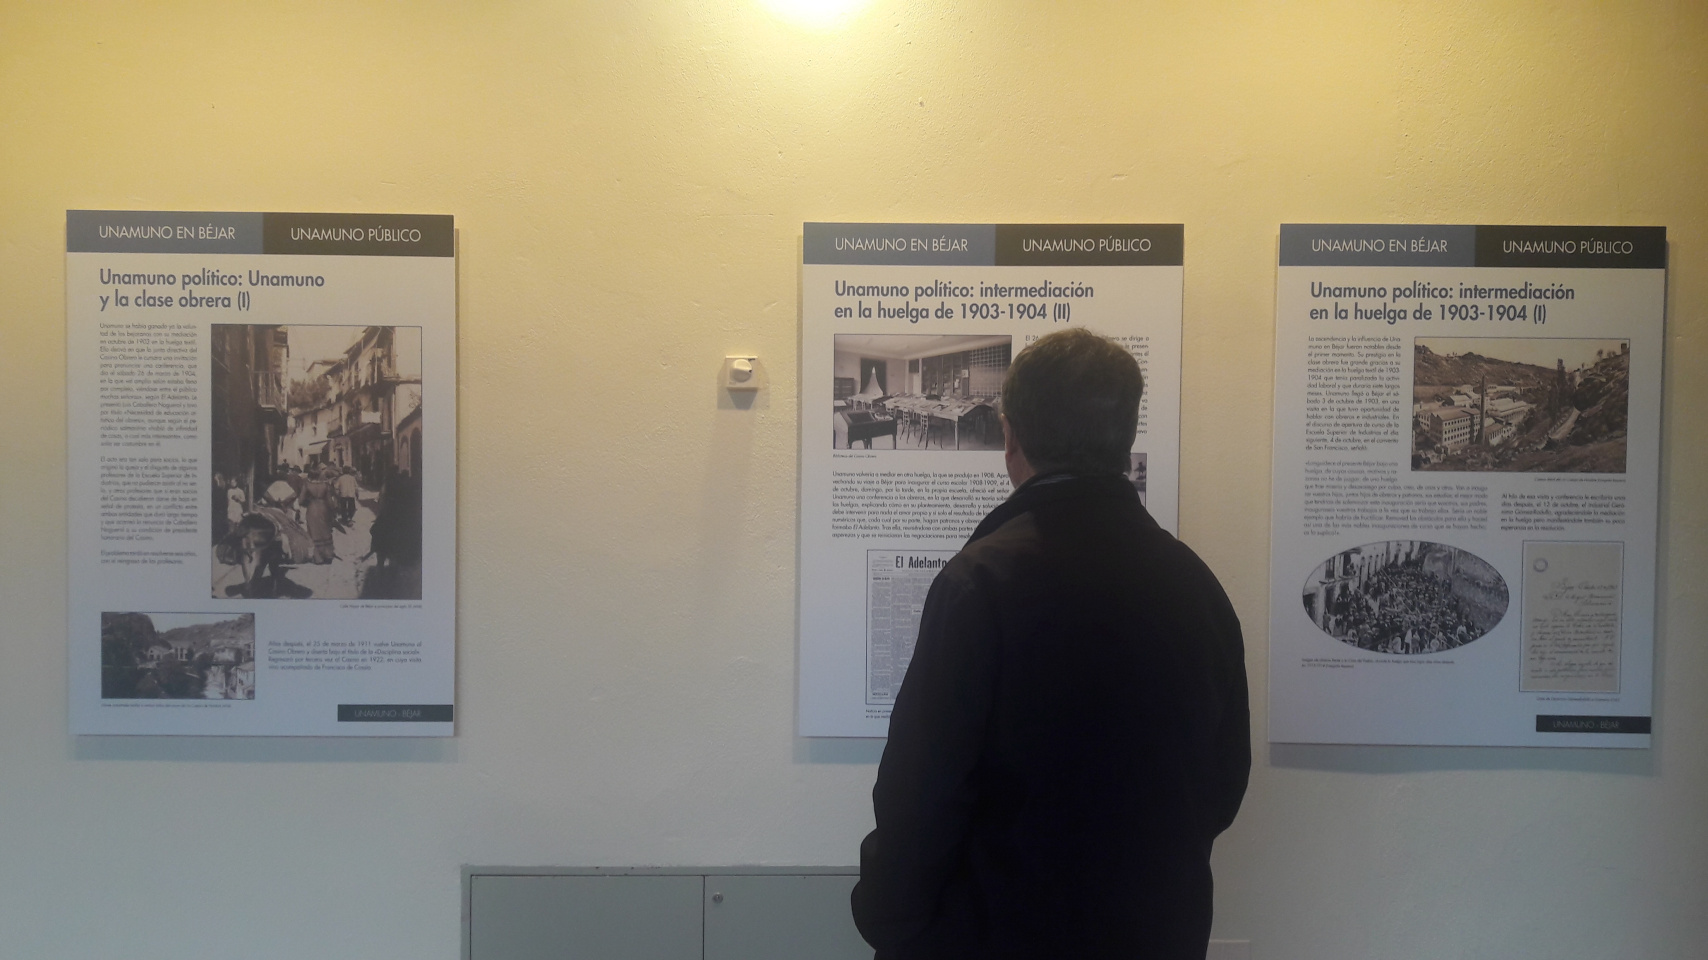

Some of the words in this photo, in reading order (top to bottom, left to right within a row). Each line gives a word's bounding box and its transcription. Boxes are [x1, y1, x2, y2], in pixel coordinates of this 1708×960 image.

[99, 225, 173, 240] UNAMUNO
[176, 225, 195, 240] EN
[198, 222, 236, 240] BÉJAR
[290, 227, 365, 242] UNAMUNO
[368, 224, 422, 243] PÚBLICO
[835, 237, 907, 252] UNAMUNO
[910, 238, 928, 252] EN
[932, 234, 969, 252] BÉJAR
[1022, 238, 1096, 252] UNAMUNO
[1099, 235, 1152, 252] PÚBLICO
[1311, 238, 1386, 253] UNAMUNO
[1388, 238, 1407, 253] EN
[1410, 236, 1448, 253] BÉJAR
[1502, 239, 1577, 254] UNAMUNO
[1580, 237, 1634, 255] PÚBLICO
[99, 267, 177, 286] Unamuno
[181, 267, 243, 290] político:
[248, 269, 325, 288] Unamuno
[98, 295, 110, 313] y
[114, 288, 130, 308] la
[134, 288, 174, 308] clase
[178, 288, 232, 309] obrera
[237, 290, 251, 312] (I)
[834, 279, 910, 298] Unamuno
[914, 279, 975, 304] político:
[979, 279, 1094, 299] intermediación
[1310, 281, 1388, 299] Unamuno
[1392, 280, 1454, 304] político:
[1459, 280, 1575, 300] intermediación
[834, 306, 853, 319] en
[858, 300, 872, 319] la
[877, 299, 930, 324] huelga
[934, 300, 954, 320] de
[960, 302, 1048, 320] 1903-1904
[1053, 302, 1071, 323] (II)
[1309, 308, 1329, 321] en
[1334, 301, 1349, 321] la
[1353, 300, 1408, 326] huelga
[1412, 301, 1433, 321] de
[1439, 303, 1528, 322] 1903-1904
[1533, 303, 1547, 325] (I)
[895, 555, 904, 569] El
[354, 709, 397, 718] UNAMUNO
[1553, 720, 1595, 729] UNAMUNO
